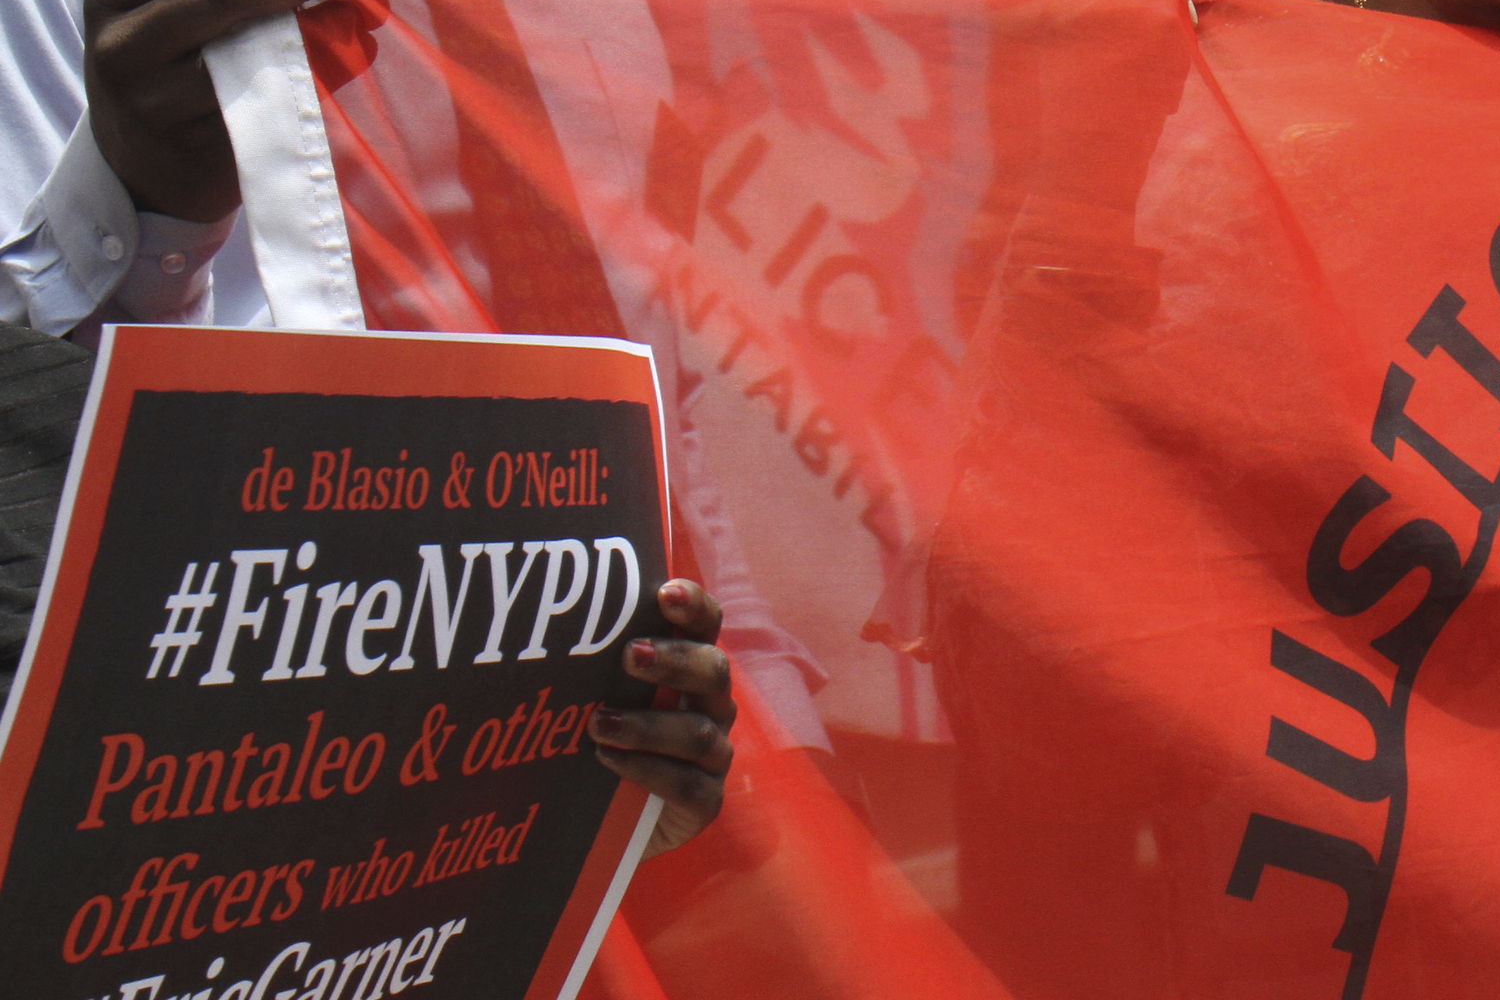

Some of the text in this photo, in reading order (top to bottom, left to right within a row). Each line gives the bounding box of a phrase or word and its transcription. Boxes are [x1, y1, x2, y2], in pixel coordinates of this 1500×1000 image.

[240, 447, 294, 512] de
[304, 449, 429, 512] Blasio
[442, 452, 474, 509] &
[145, 536, 641, 687] #FireNYPD
[77, 686, 606, 831] Pantaleo & other
[62, 804, 540, 965] officers who killed
